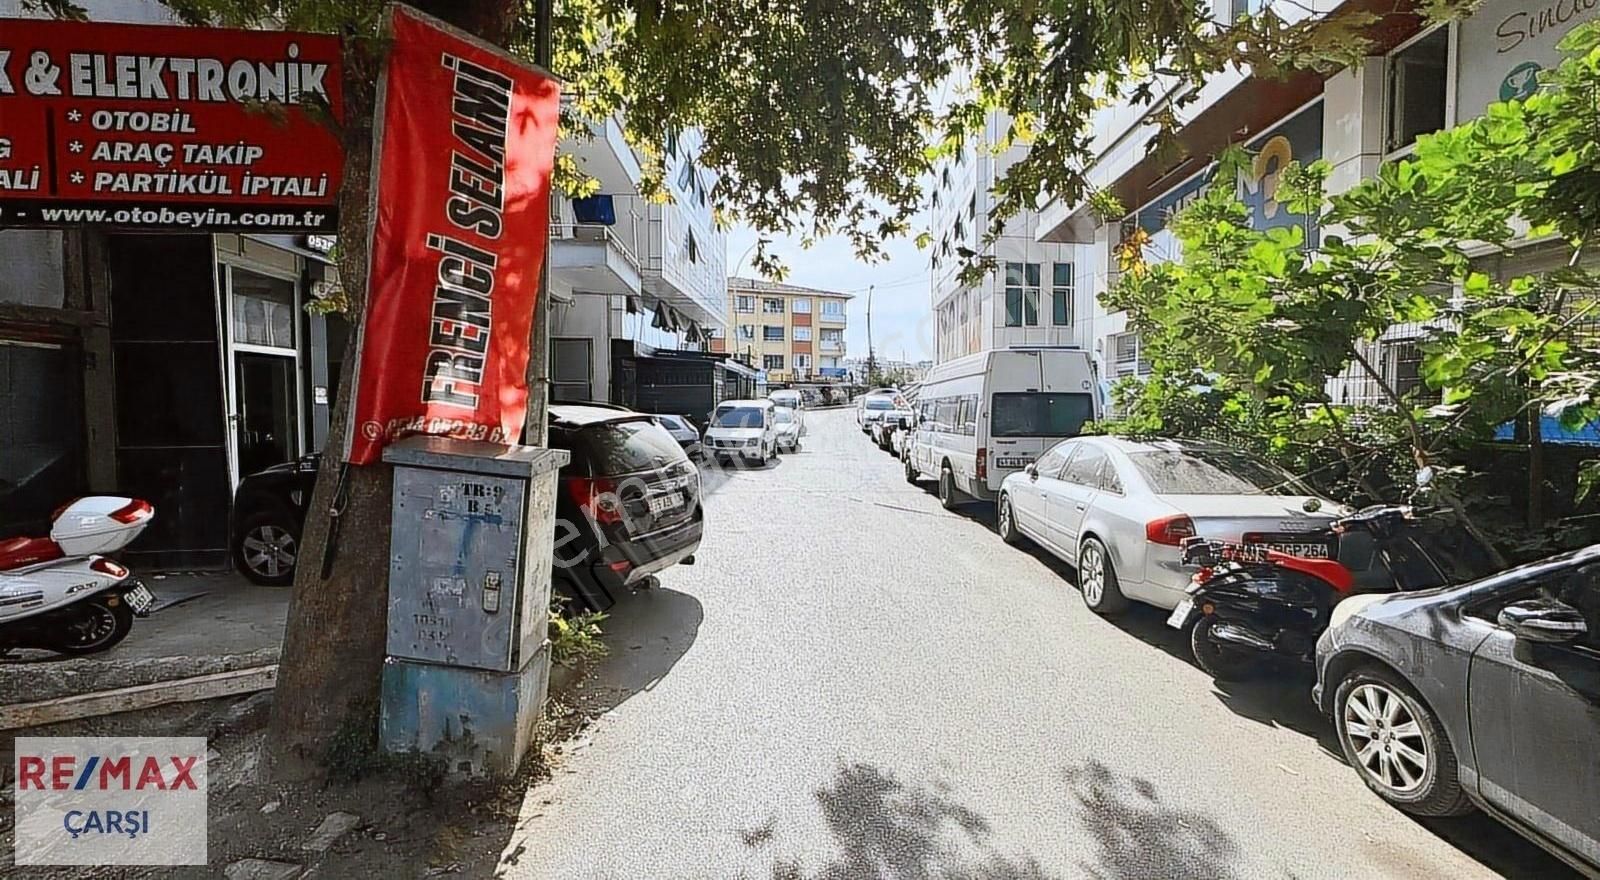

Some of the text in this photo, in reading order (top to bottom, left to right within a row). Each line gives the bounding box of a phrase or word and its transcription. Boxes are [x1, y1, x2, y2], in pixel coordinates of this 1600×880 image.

[25, 51, 61, 95] &
[70, 43, 329, 104] ELEKTRONİK
[91, 108, 196, 133] OTOBİL
[91, 140, 264, 168] ARAÇ TAKİP
[94, 169, 328, 197] PARTİKÜL İPTALİ
[41, 207, 325, 228] www.otobeyin.com.tr
[420, 52, 514, 411] FRENCİ SELAMİ
